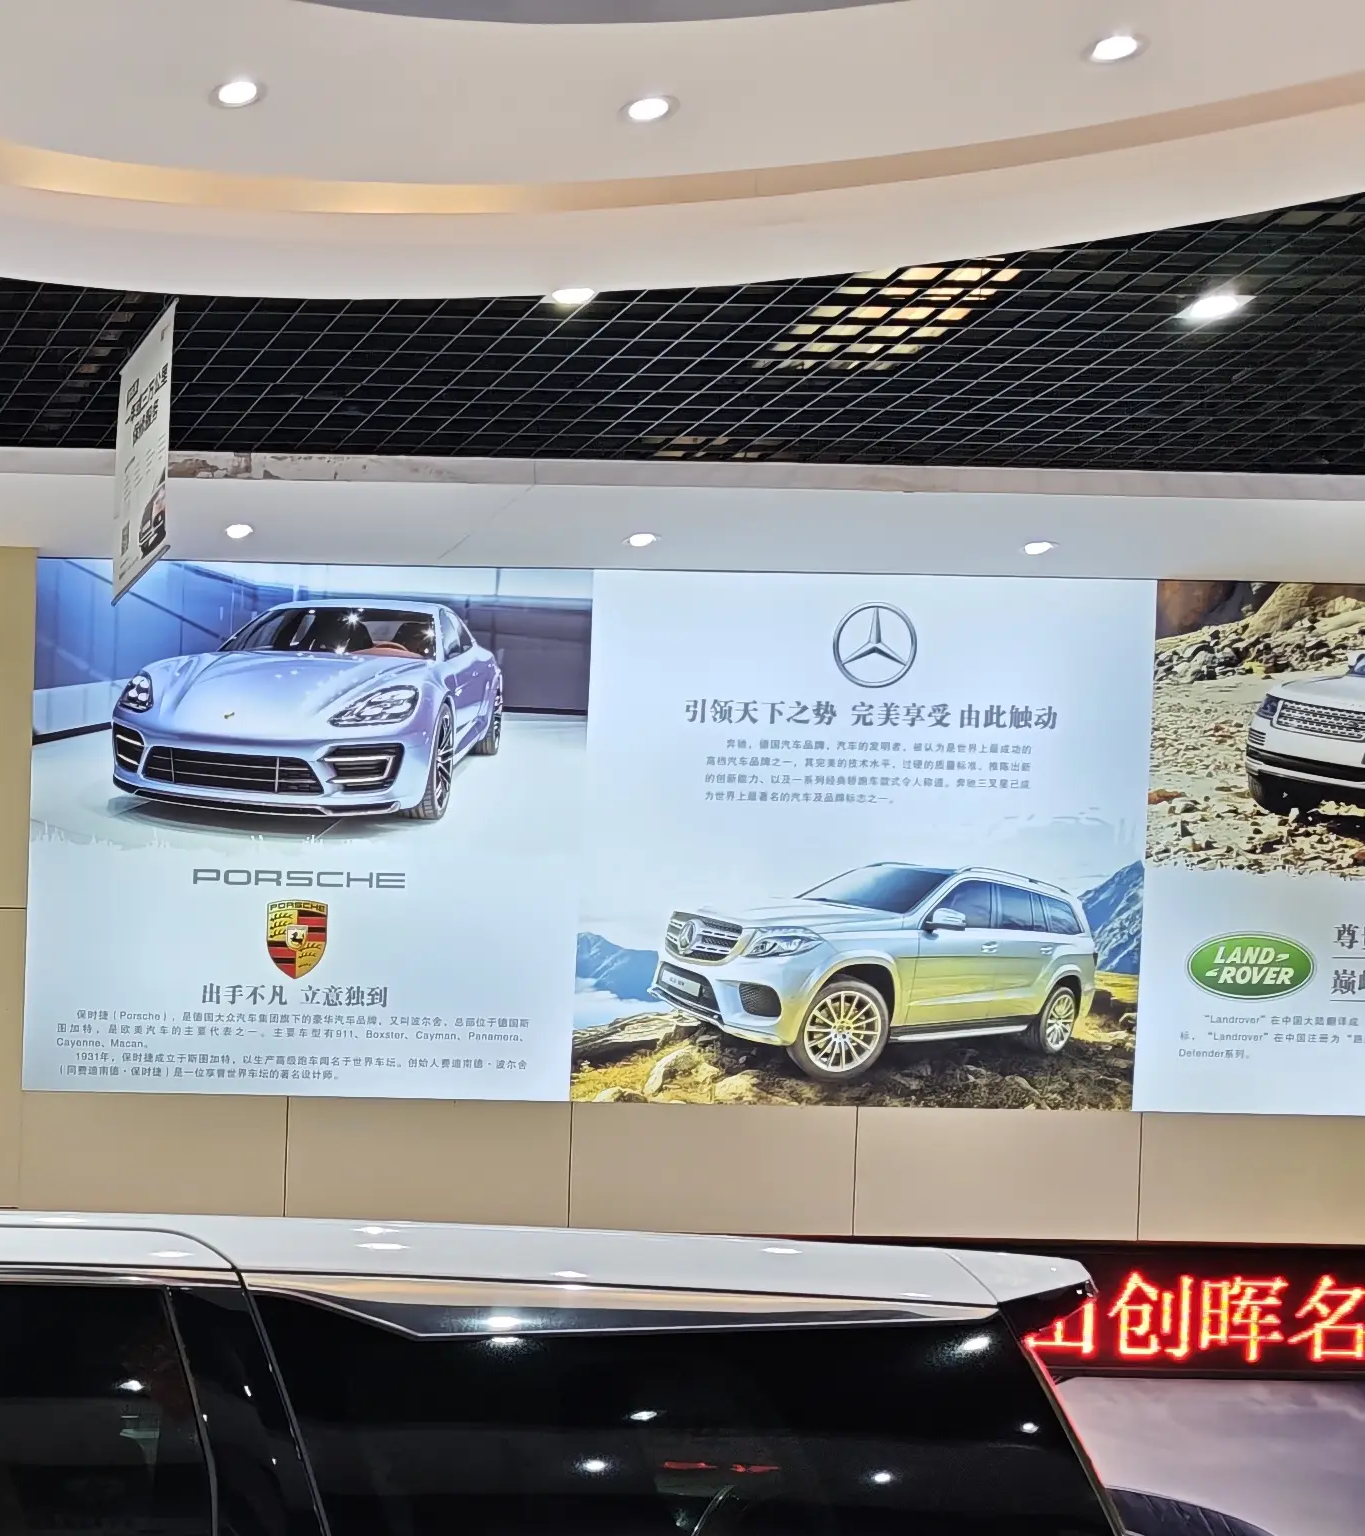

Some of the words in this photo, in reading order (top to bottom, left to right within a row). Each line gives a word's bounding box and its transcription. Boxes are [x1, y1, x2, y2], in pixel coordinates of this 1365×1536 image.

[685, 698, 837, 727] 引领天下之势
[851, 701, 951, 729] 完美享受
[960, 704, 1058, 730] 由此触动
[192, 868, 406, 889] PORSCHE
[270, 901, 326, 913] PORSCHE
[1333, 924, 1365, 949] 尊
[1214, 946, 1276, 965] LAND
[1217, 966, 1295, 985] ROVER
[202, 983, 288, 1006] 出手不凡
[300, 986, 388, 1009] 立意独到
